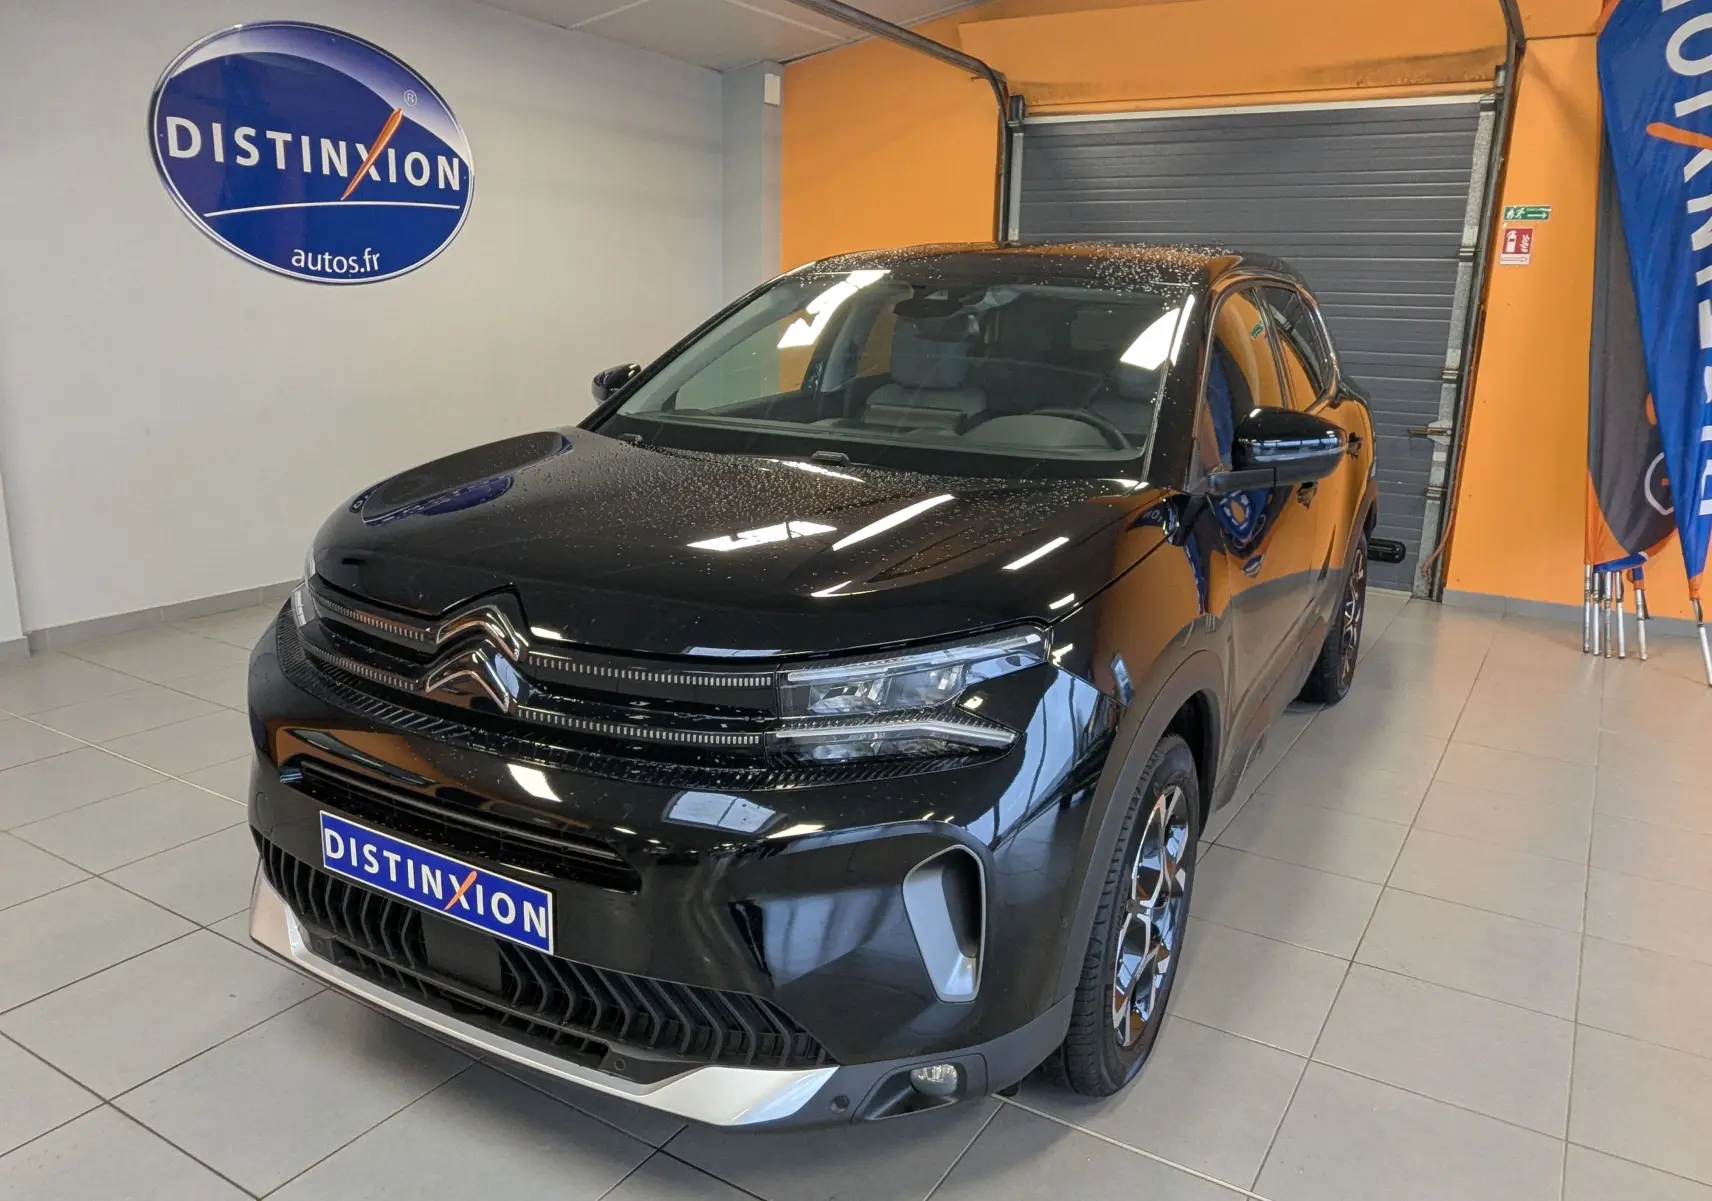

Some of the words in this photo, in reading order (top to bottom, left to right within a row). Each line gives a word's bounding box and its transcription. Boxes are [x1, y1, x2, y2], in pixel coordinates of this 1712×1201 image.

[166, 108, 460, 200] DISTINXION
[291, 248, 380, 274] autos.fr
[324, 827, 547, 938] DISTINXION
